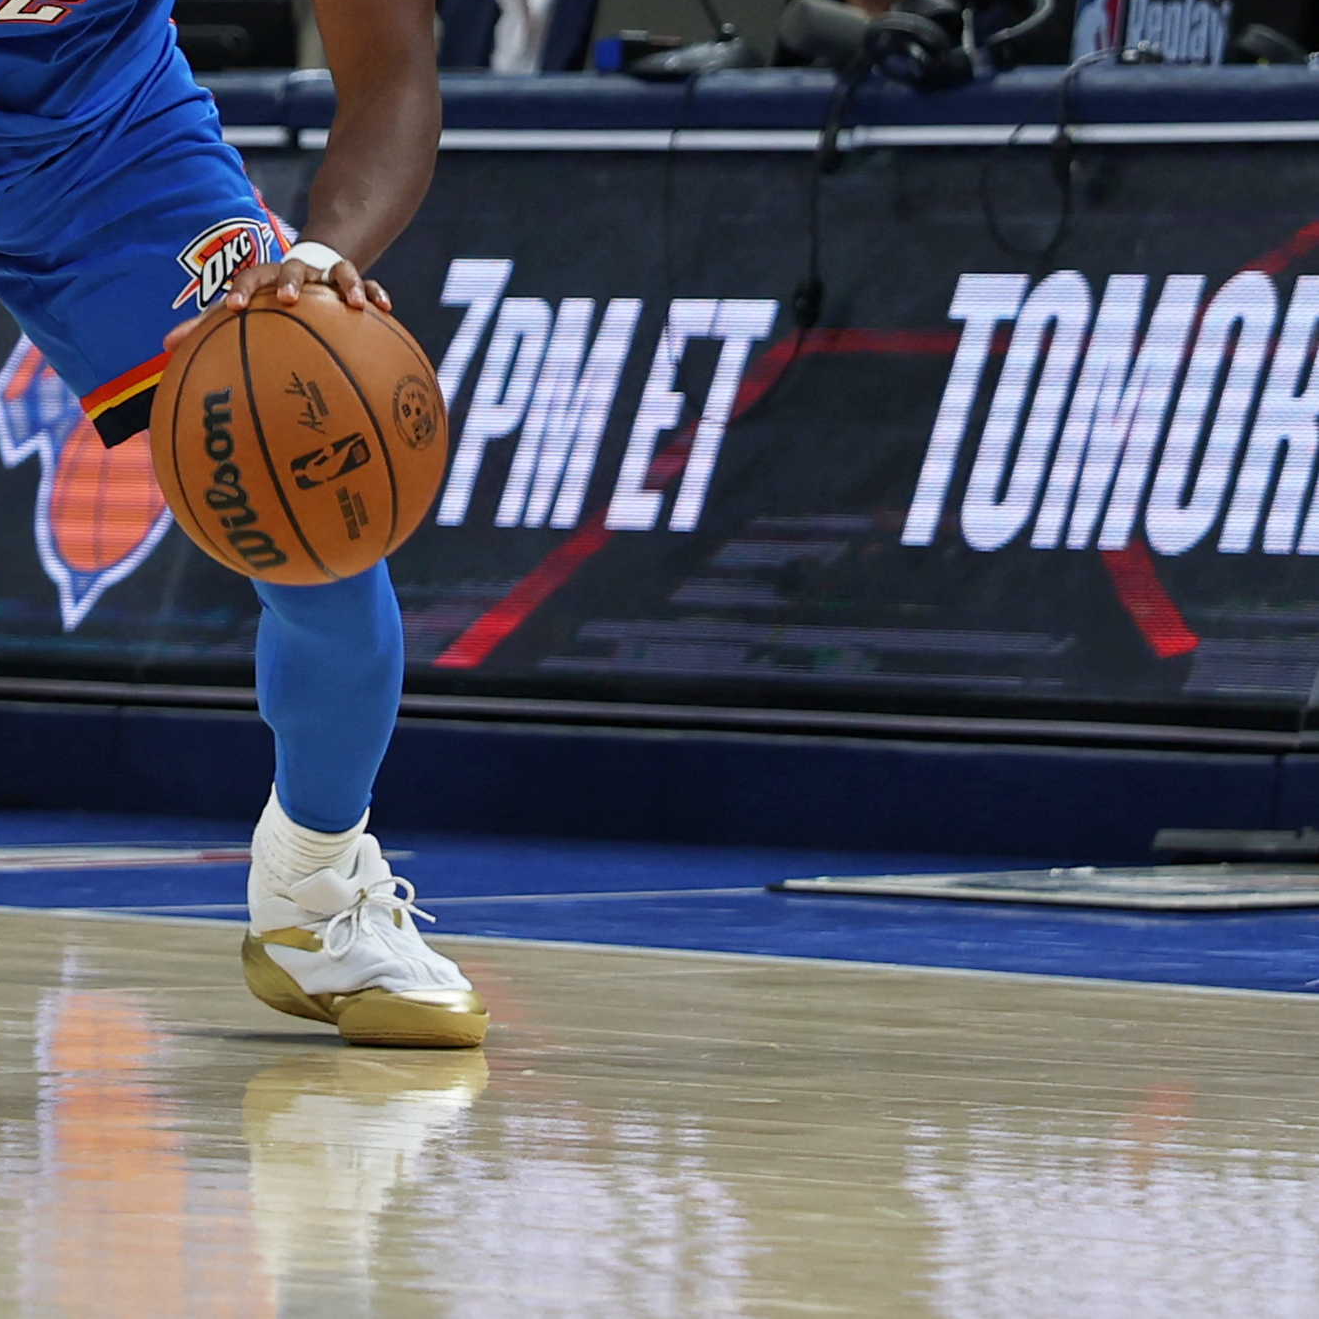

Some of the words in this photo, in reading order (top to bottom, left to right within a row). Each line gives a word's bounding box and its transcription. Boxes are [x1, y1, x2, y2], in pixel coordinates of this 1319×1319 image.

[200, 230, 253, 304] OKC
[202, 385, 290, 571] Wilson
[603, 297, 779, 532] ET
[900, 269, 1319, 557] TOMOR
